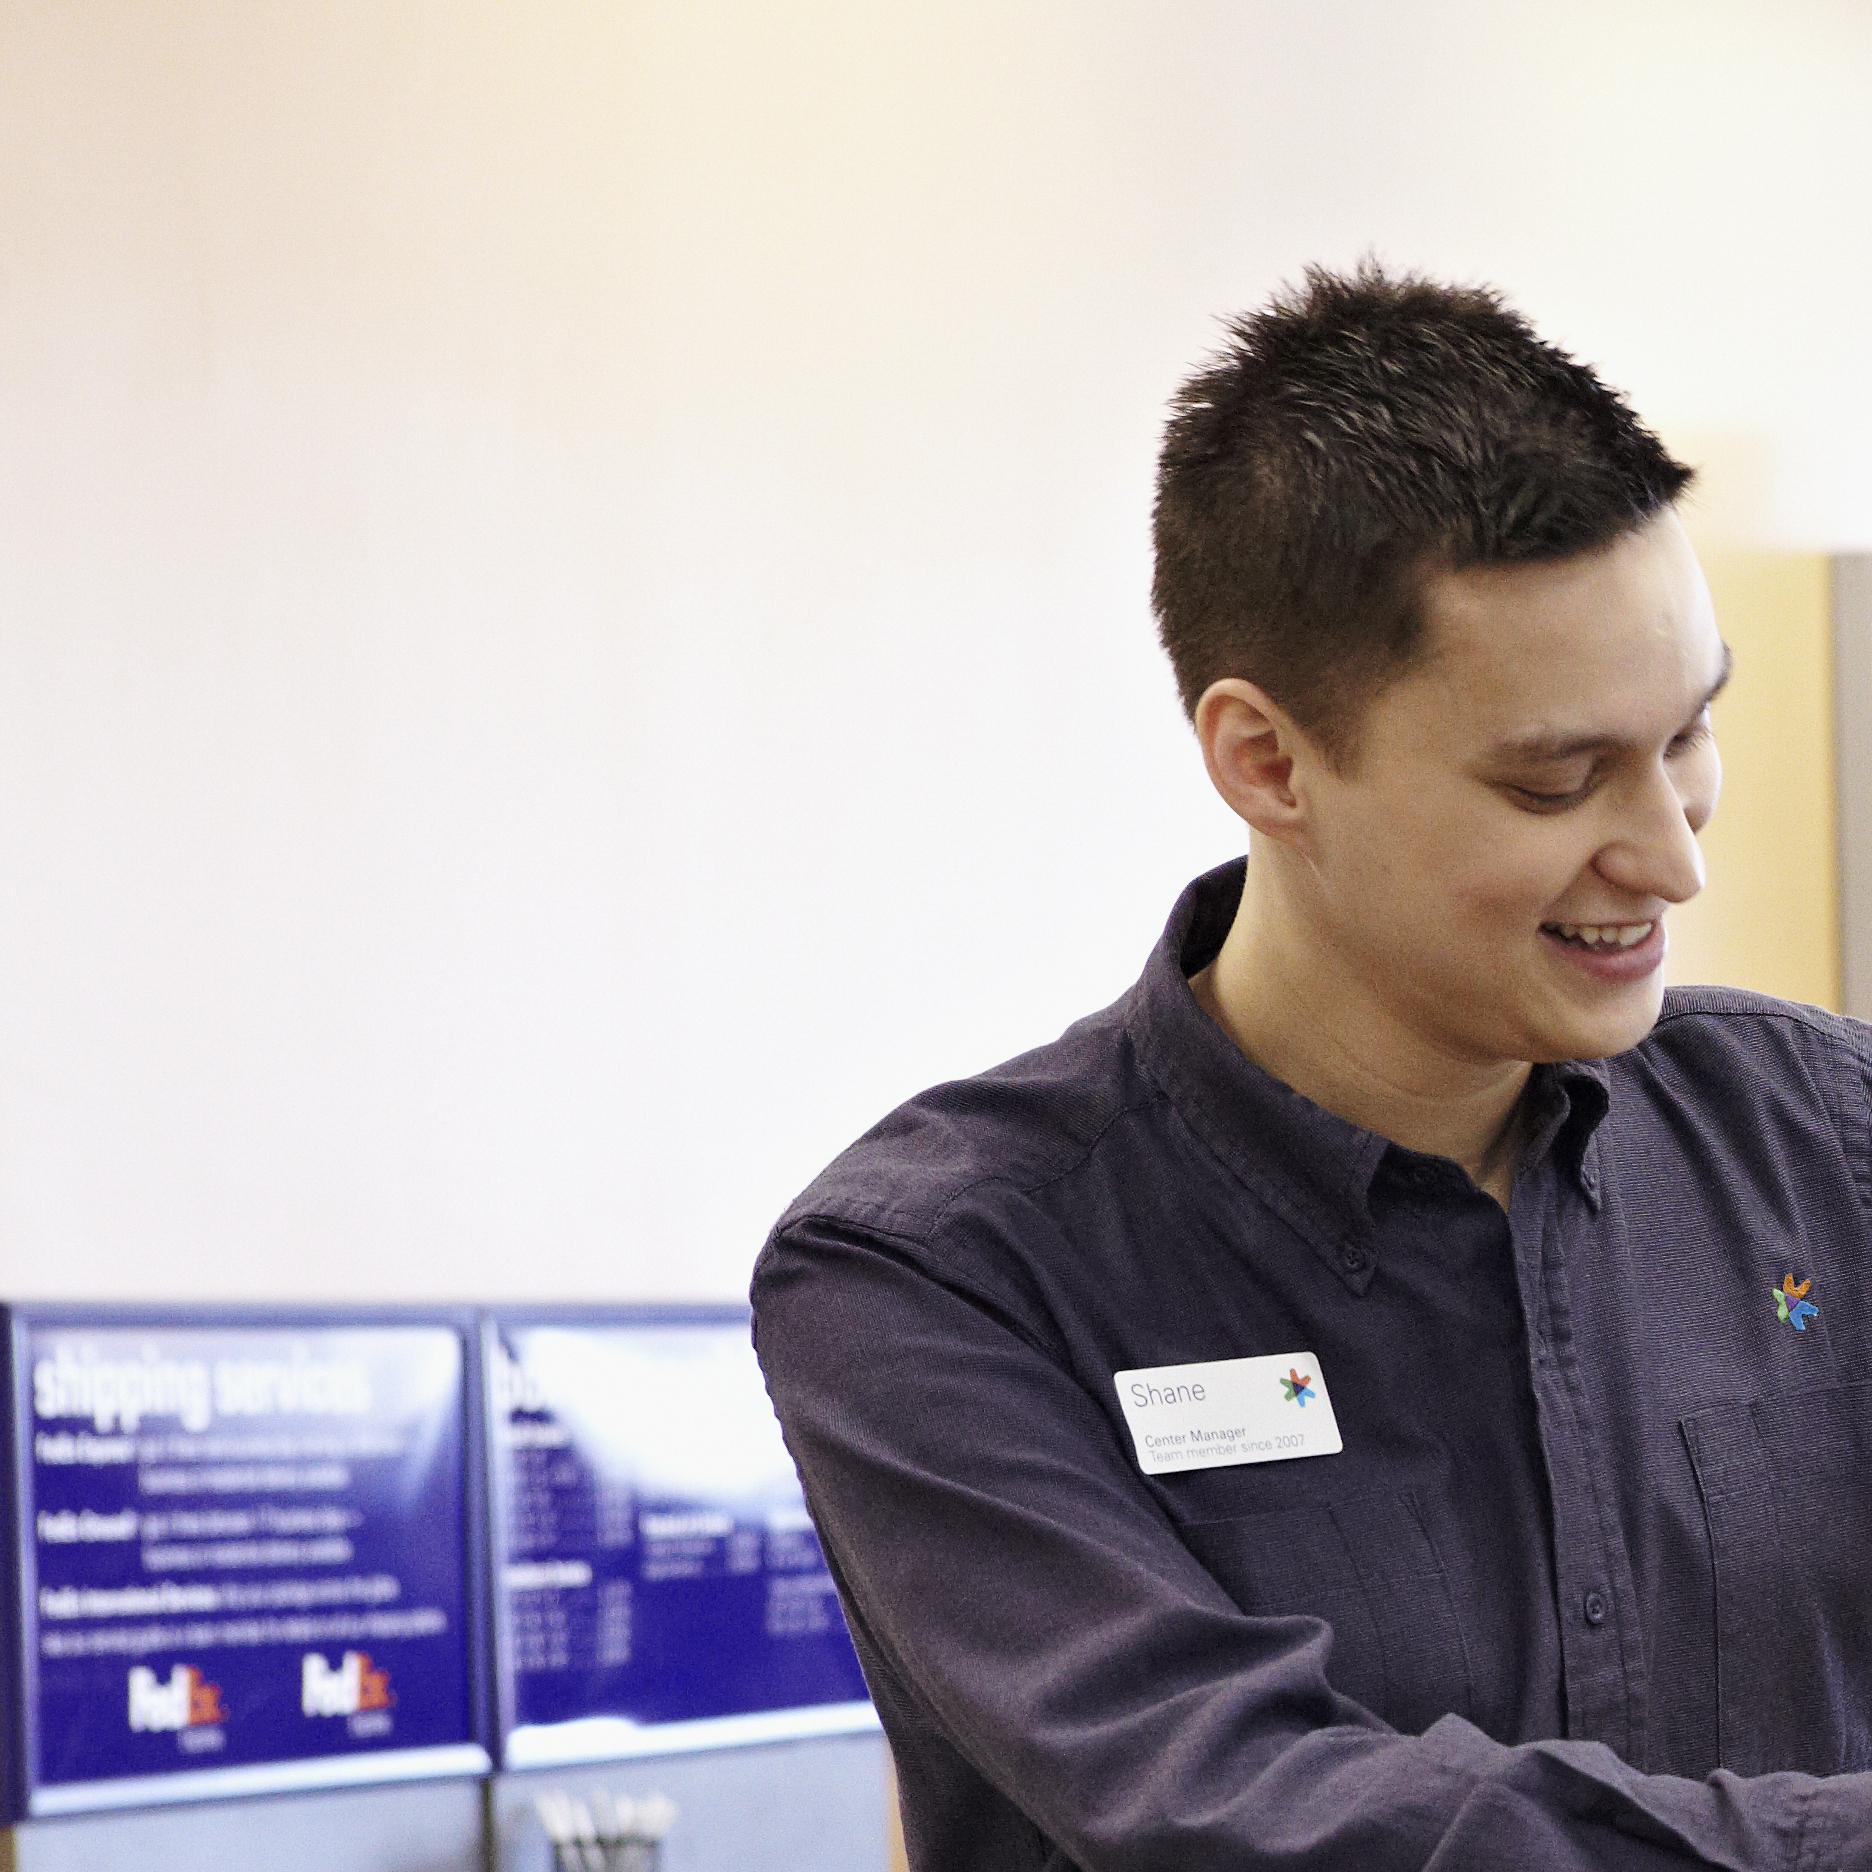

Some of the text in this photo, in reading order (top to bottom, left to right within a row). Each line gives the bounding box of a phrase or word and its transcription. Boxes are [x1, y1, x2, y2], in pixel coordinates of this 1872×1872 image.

[33, 1341, 210, 1432] shipping
[1130, 1382, 1207, 1408] Shane
[1145, 1426, 1247, 1449] Center Manager
[1149, 1433, 1306, 1464] Team member since 2007
